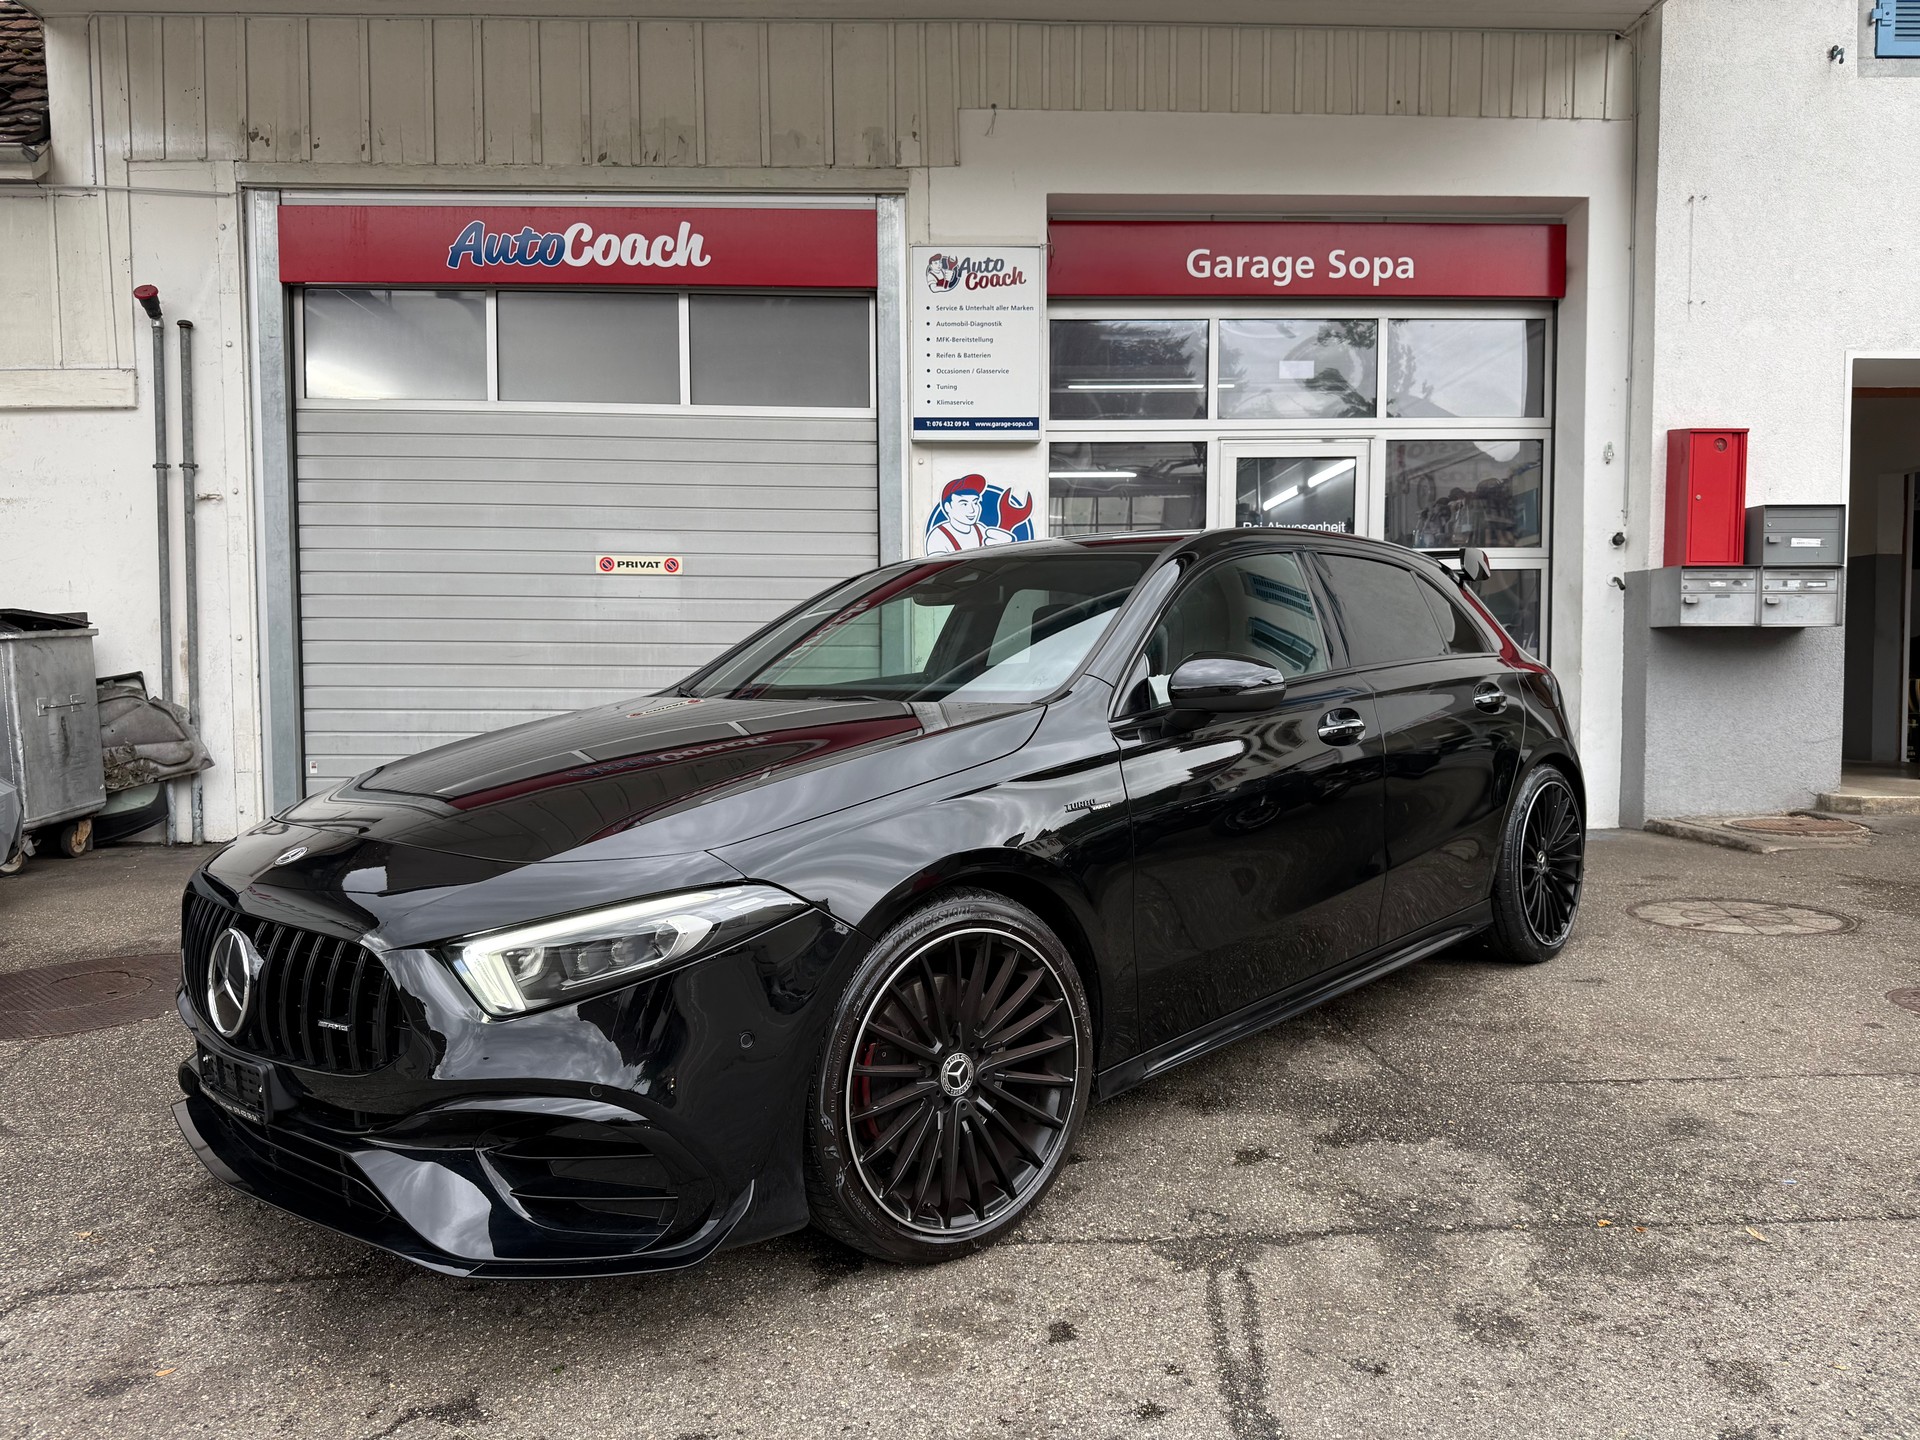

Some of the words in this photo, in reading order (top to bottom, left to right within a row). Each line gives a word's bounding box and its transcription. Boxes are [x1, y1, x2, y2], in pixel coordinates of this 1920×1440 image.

[957, 257, 1005, 278] Auto
[1186, 248, 1315, 287] Garage
[1328, 248, 1415, 287] Sopa
[965, 266, 1027, 291] Coach
[935, 304, 958, 312] Service
[965, 304, 995, 312] Unterhalt
[935, 320, 1003, 328] Automobil-Diagnostik
[935, 336, 994, 344] MFK-Bereitstellung
[975, 367, 1010, 375] Glasservice
[936, 383, 958, 392] Tuning
[975, 420, 1034, 429] www.garage-sopa.ch
[617, 560, 661, 569] PRIVAT
